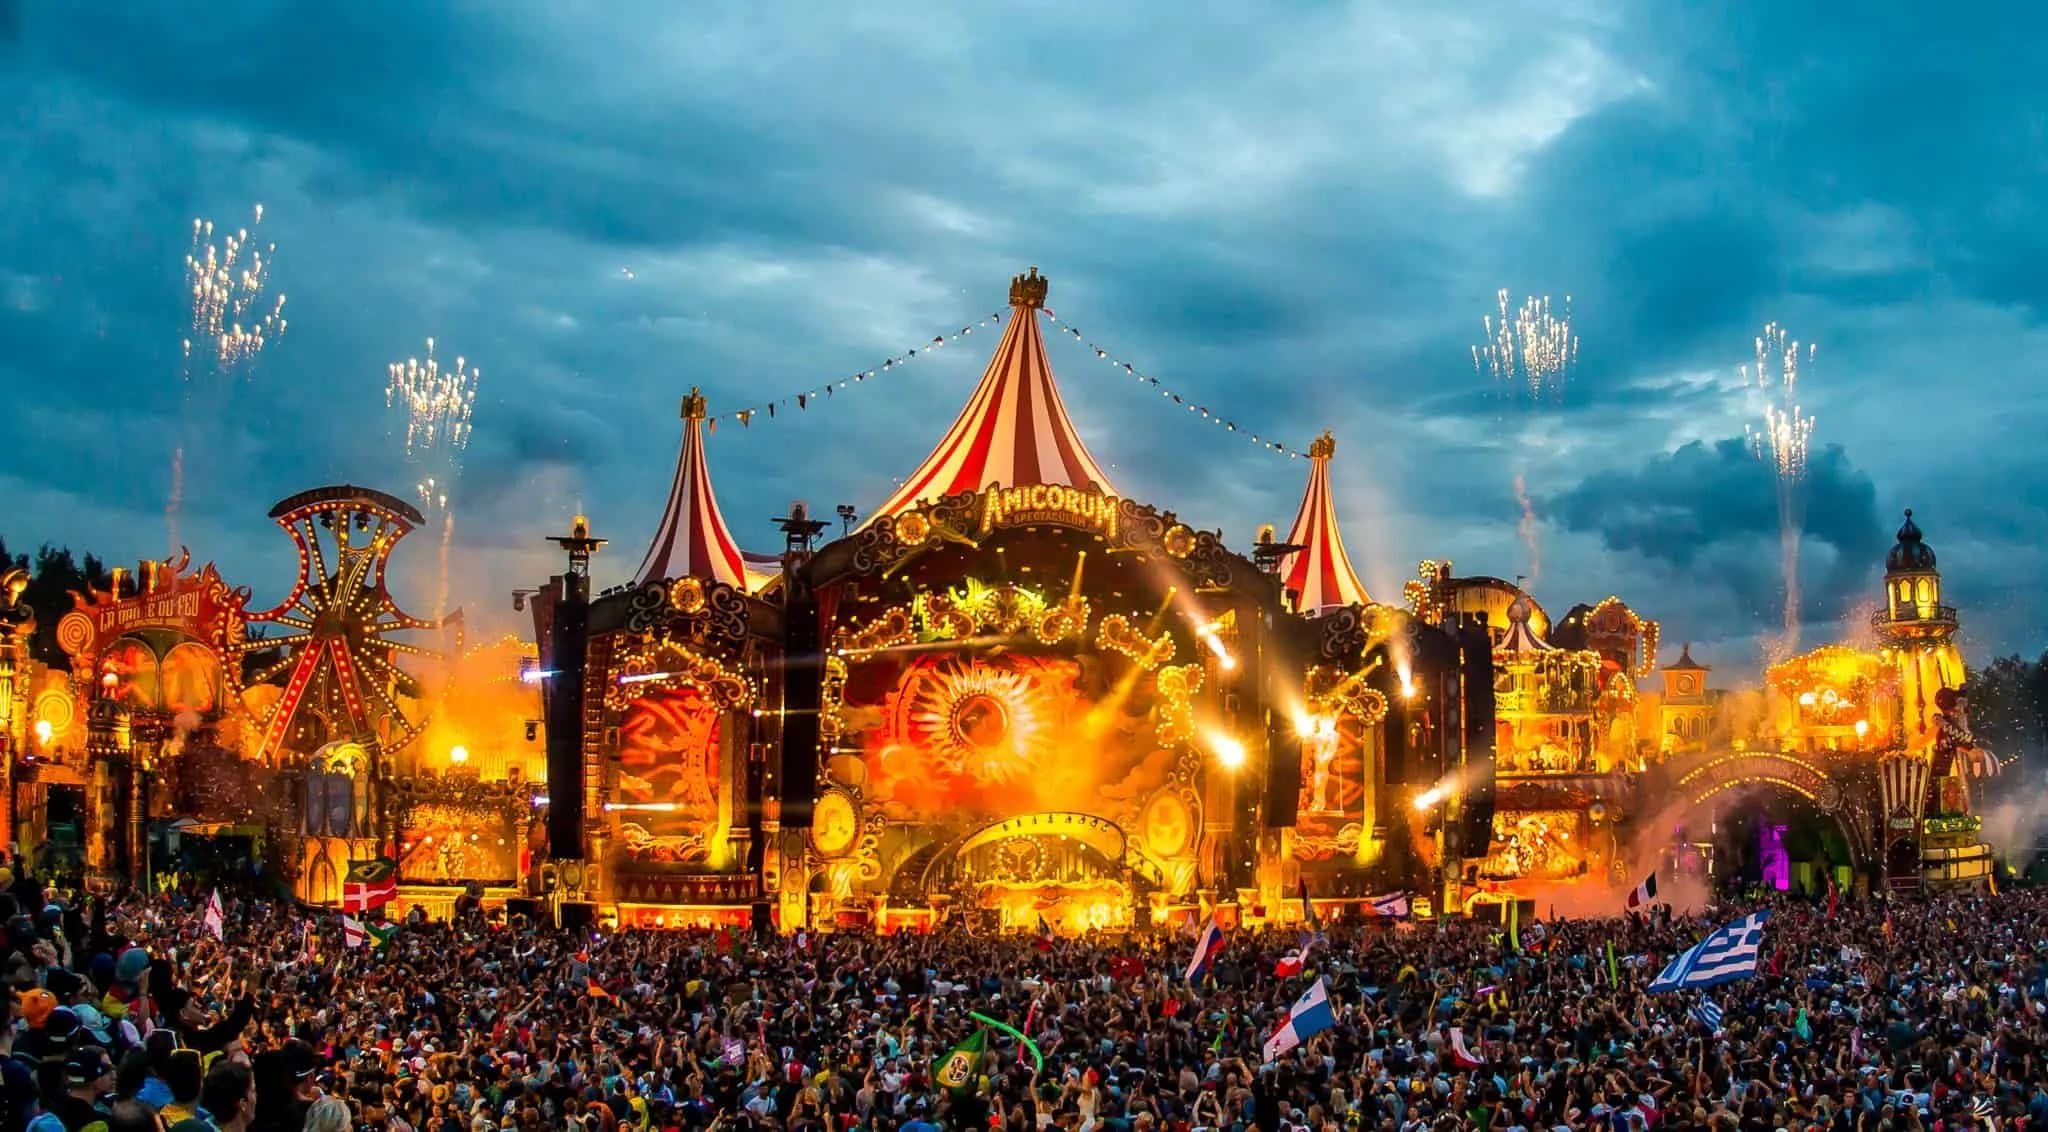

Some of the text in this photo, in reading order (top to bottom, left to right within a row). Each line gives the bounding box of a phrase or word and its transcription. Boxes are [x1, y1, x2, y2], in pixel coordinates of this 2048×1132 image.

[982, 485, 1117, 538] AMICORUM
[158, 599, 173, 617] DU
[178, 591, 199, 617] FEU
